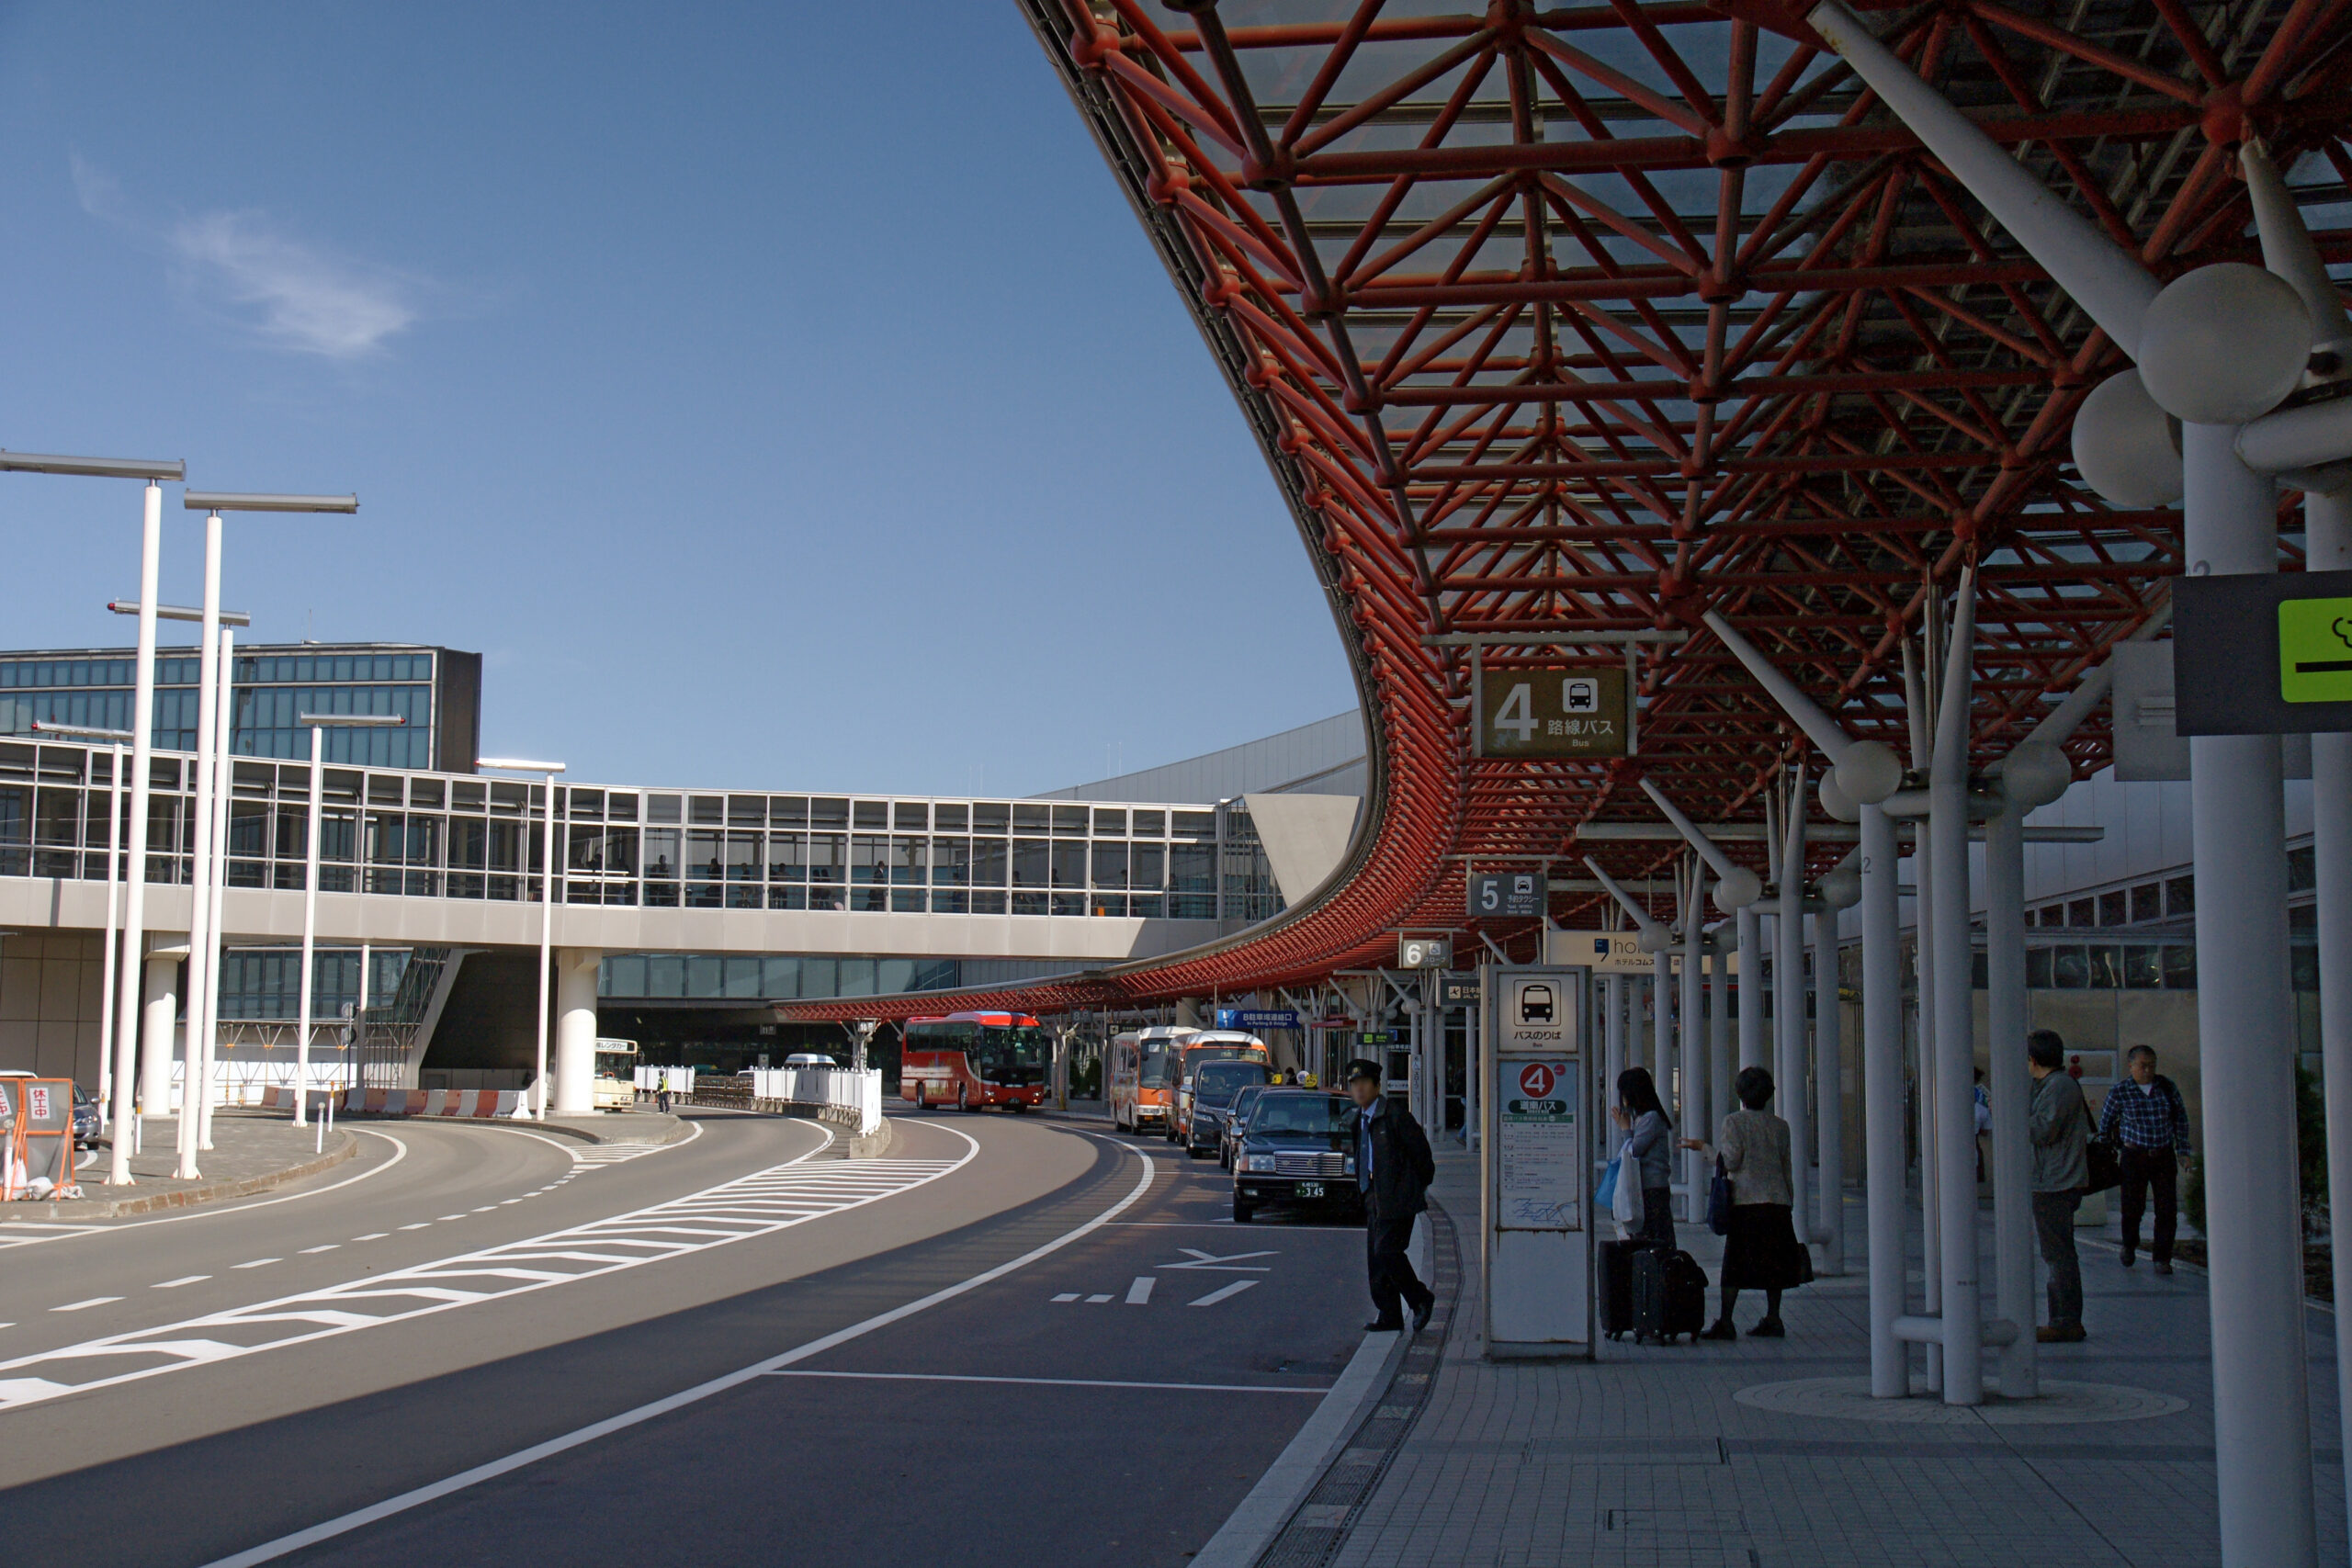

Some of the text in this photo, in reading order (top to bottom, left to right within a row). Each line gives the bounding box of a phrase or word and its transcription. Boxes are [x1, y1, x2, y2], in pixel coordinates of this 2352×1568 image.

[1494, 682, 1539, 742] 4
[1547, 719, 1614, 735] 路線バス
[1572, 739, 1590, 747] Bus
[1863, 856, 1871, 874] 2
[1481, 880, 1499, 910] 5
[1407, 943, 1422, 964] 6
[1513, 1031, 1562, 1041] バスのりば
[1523, 1066, 1546, 1093] 4
[33, 1089, 47, 1117] 休工中
